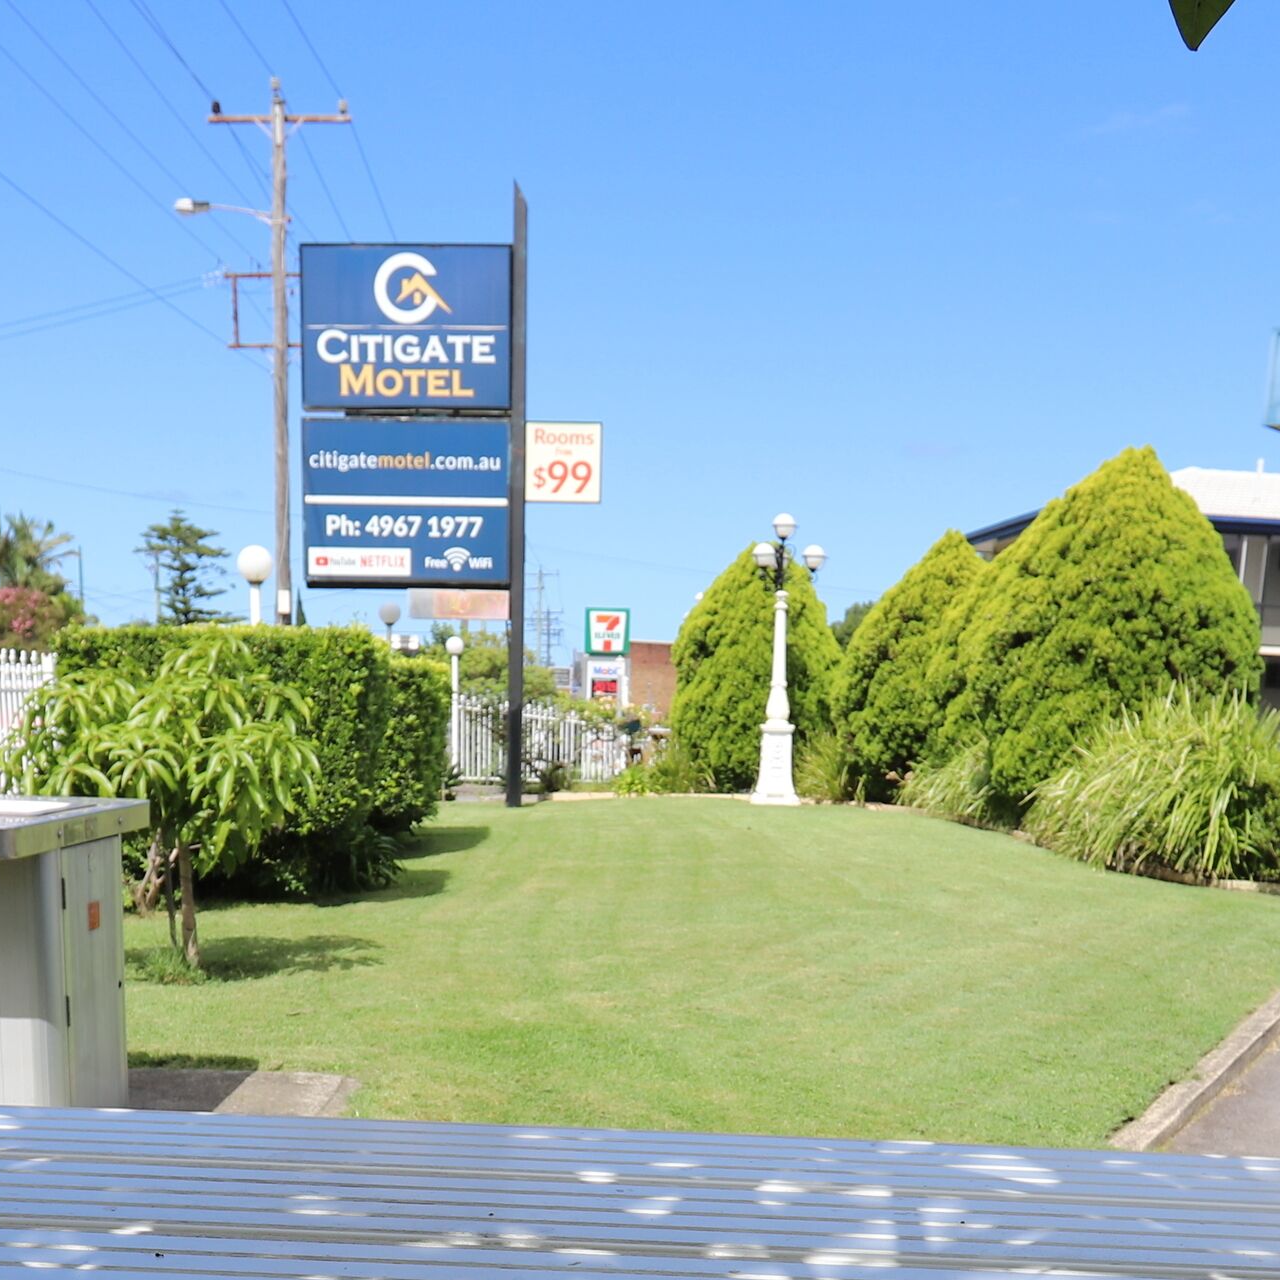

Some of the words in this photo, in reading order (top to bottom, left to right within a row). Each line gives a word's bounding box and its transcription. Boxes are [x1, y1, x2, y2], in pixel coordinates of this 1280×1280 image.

[316, 329, 497, 365] CITIGATE
[339, 363, 475, 397] MOTEL
[534, 428, 595, 446] Rooms
[309, 450, 502, 473] citigatemotel.com.au
[533, 460, 593, 495] $99
[325, 514, 361, 537] Ph:
[364, 515, 422, 538] 4967
[427, 516, 484, 539] 1977
[360, 555, 406, 568] NETFLIX
[424, 556, 448, 569] Free
